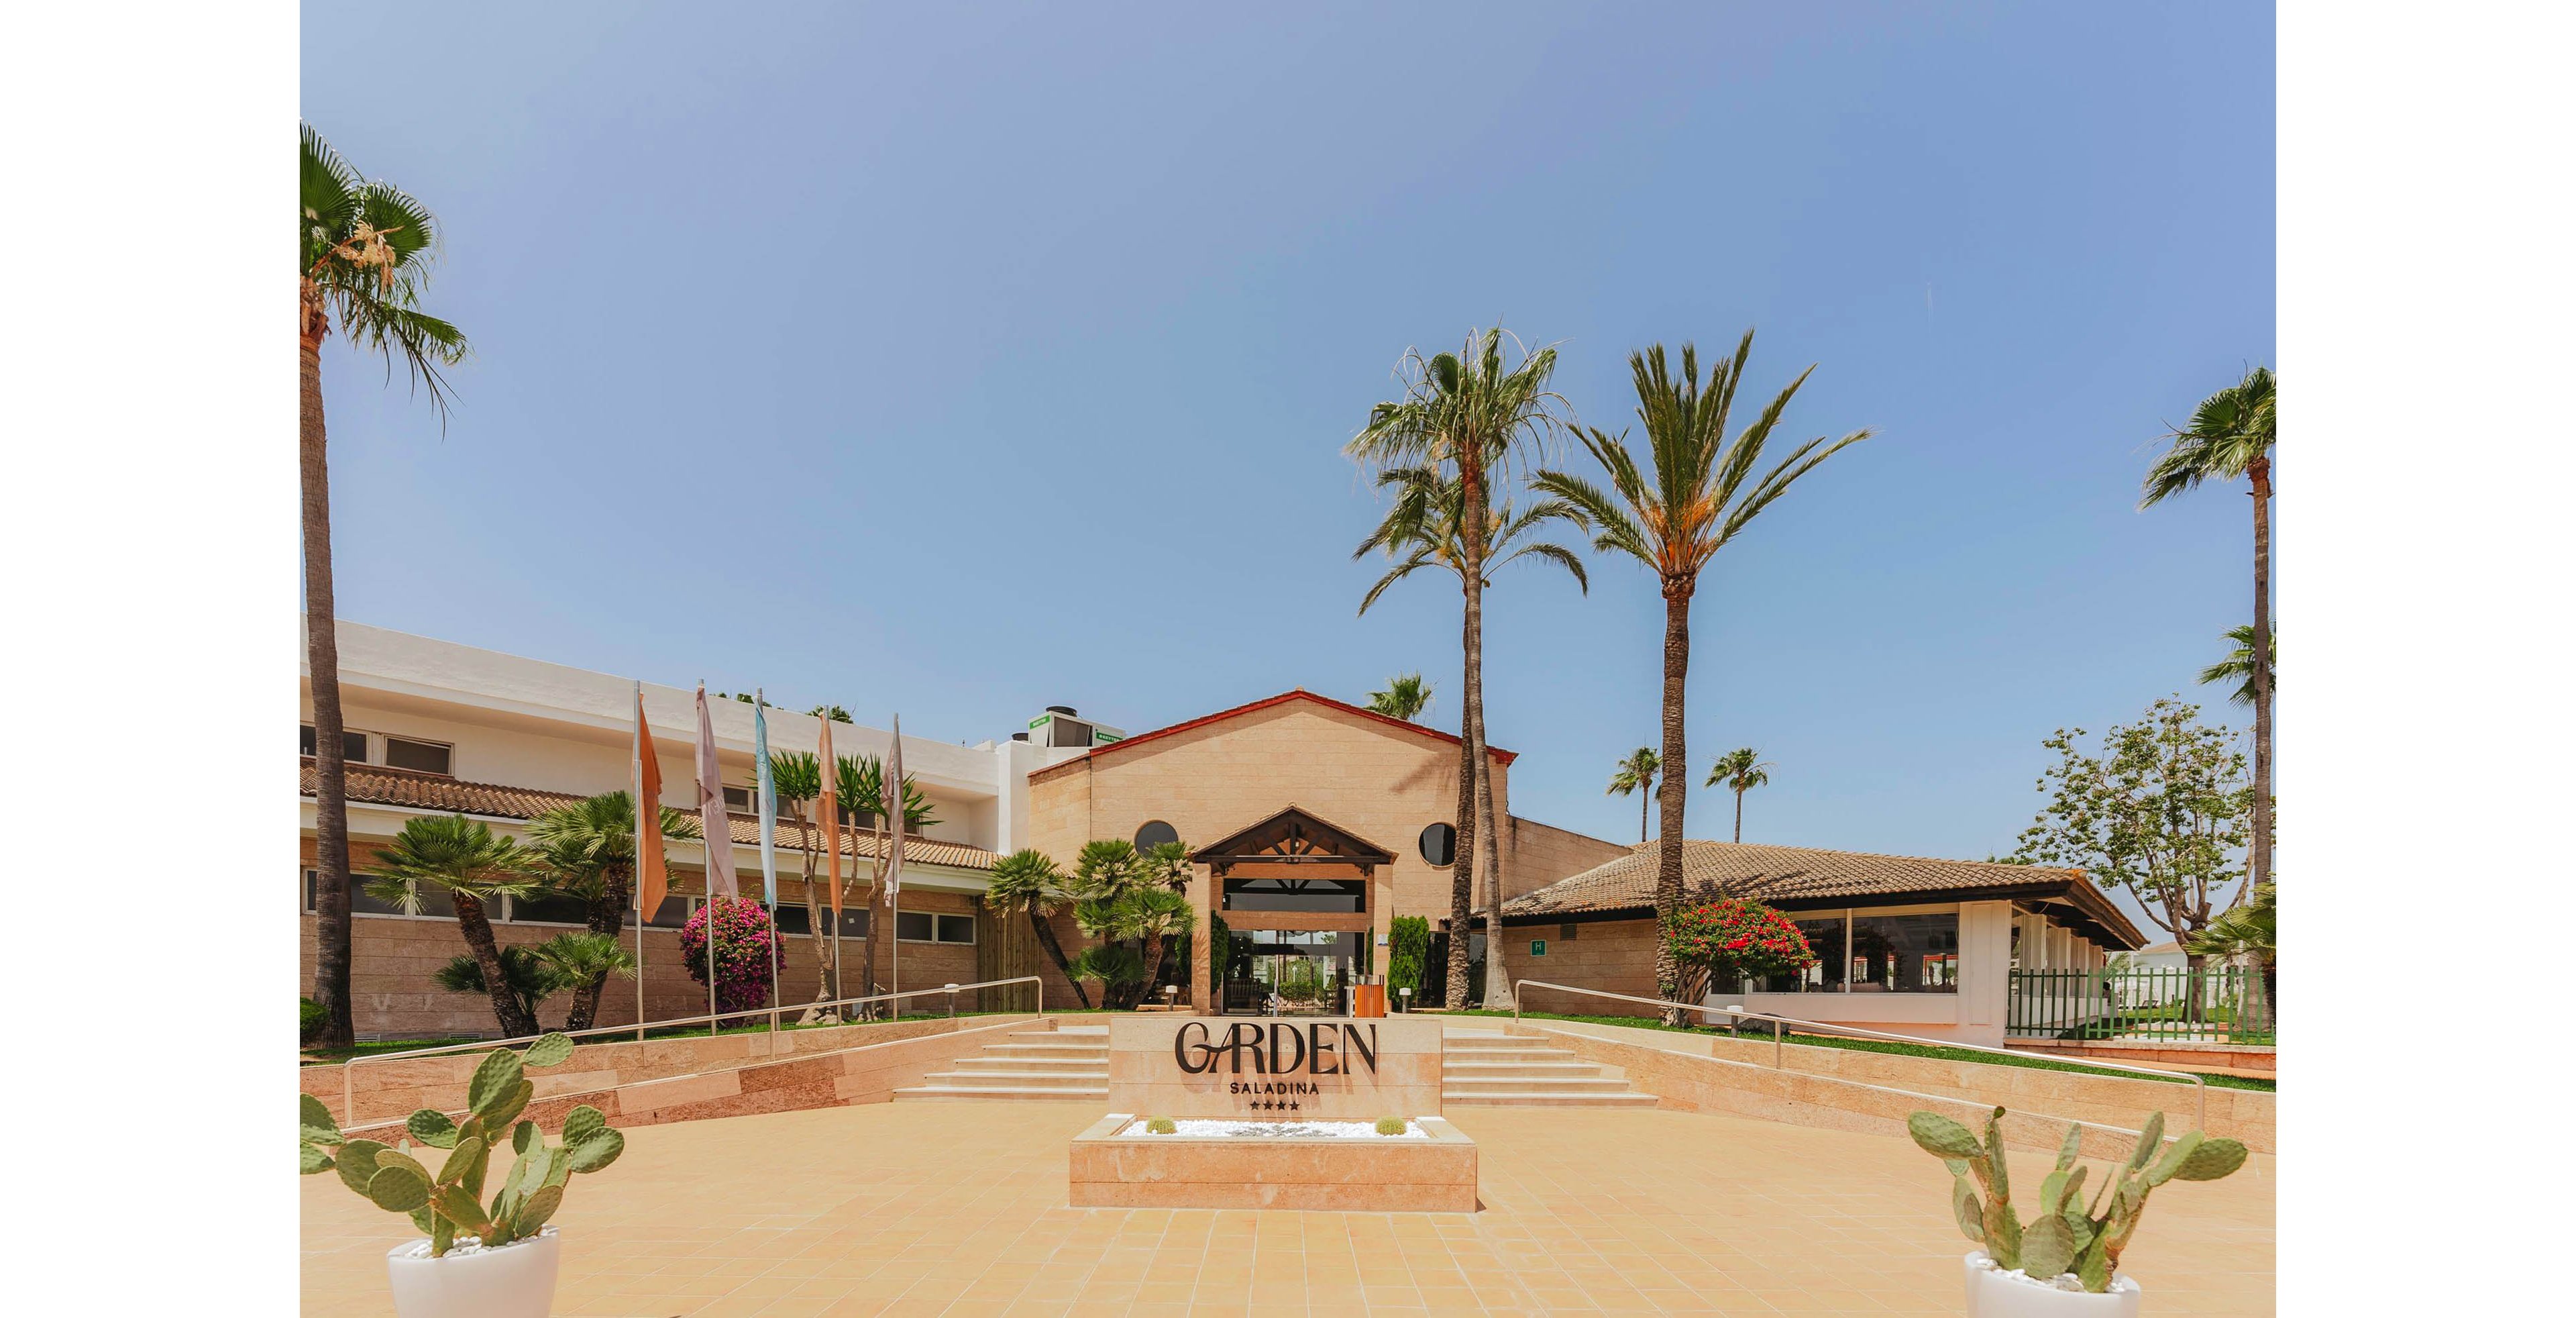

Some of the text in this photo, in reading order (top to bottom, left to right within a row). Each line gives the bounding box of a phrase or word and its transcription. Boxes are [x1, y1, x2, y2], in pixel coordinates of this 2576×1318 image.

[1535, 942, 1542, 950] H
[1175, 1022, 1376, 1074] GARDEN
[1230, 1082, 1320, 1095] SALADINA
